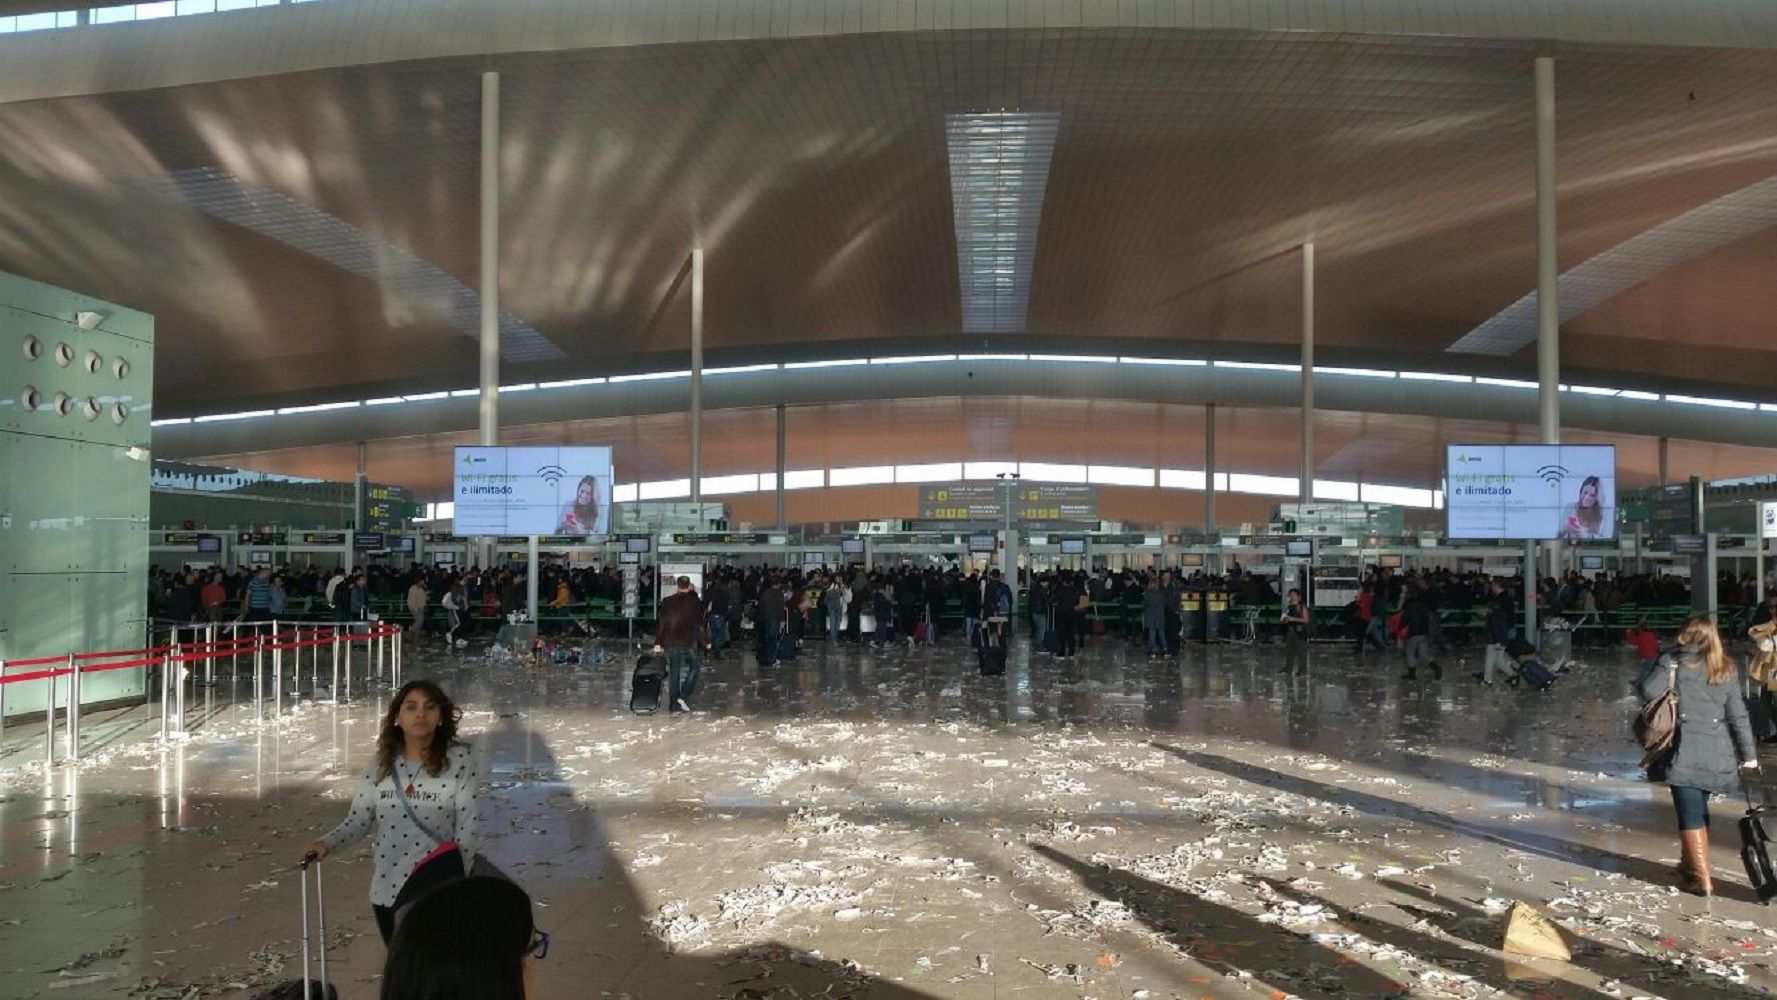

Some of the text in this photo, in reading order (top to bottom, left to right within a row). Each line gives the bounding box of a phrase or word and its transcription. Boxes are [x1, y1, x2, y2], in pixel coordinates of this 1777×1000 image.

[461, 484, 513, 495] e ilimitado
[1464, 485, 1512, 495] ilimitado
